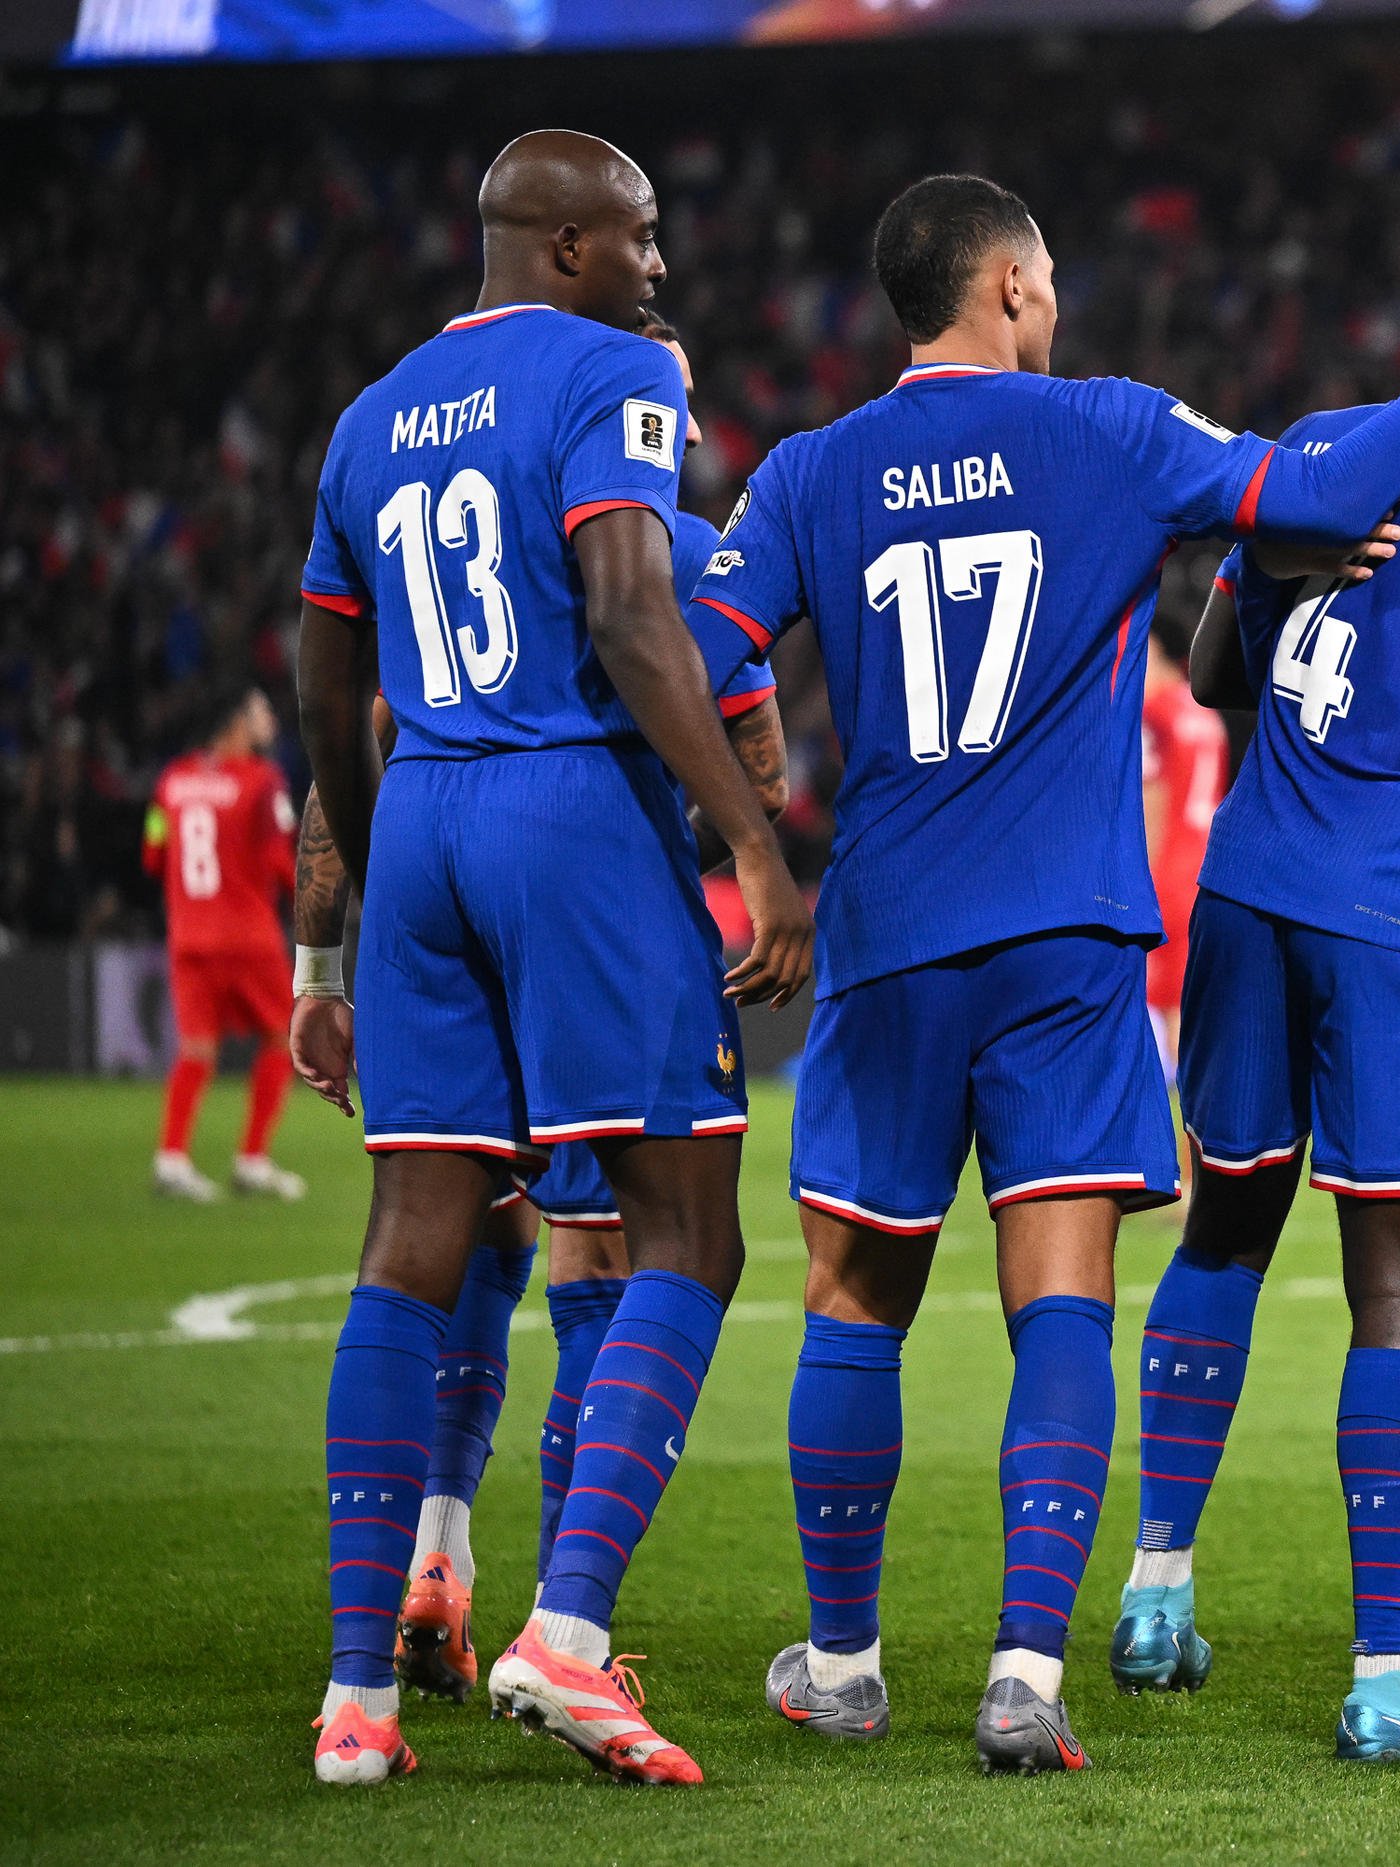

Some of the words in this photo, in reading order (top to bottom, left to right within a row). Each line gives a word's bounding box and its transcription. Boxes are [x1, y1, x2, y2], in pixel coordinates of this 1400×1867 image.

[391, 385, 496, 454] MATETA
[882, 452, 1014, 511] SALIBA
[377, 468, 518, 708] 13
[864, 530, 1044, 764] 17
[1273, 572, 1358, 744] 4
[180, 802, 222, 900] 8
